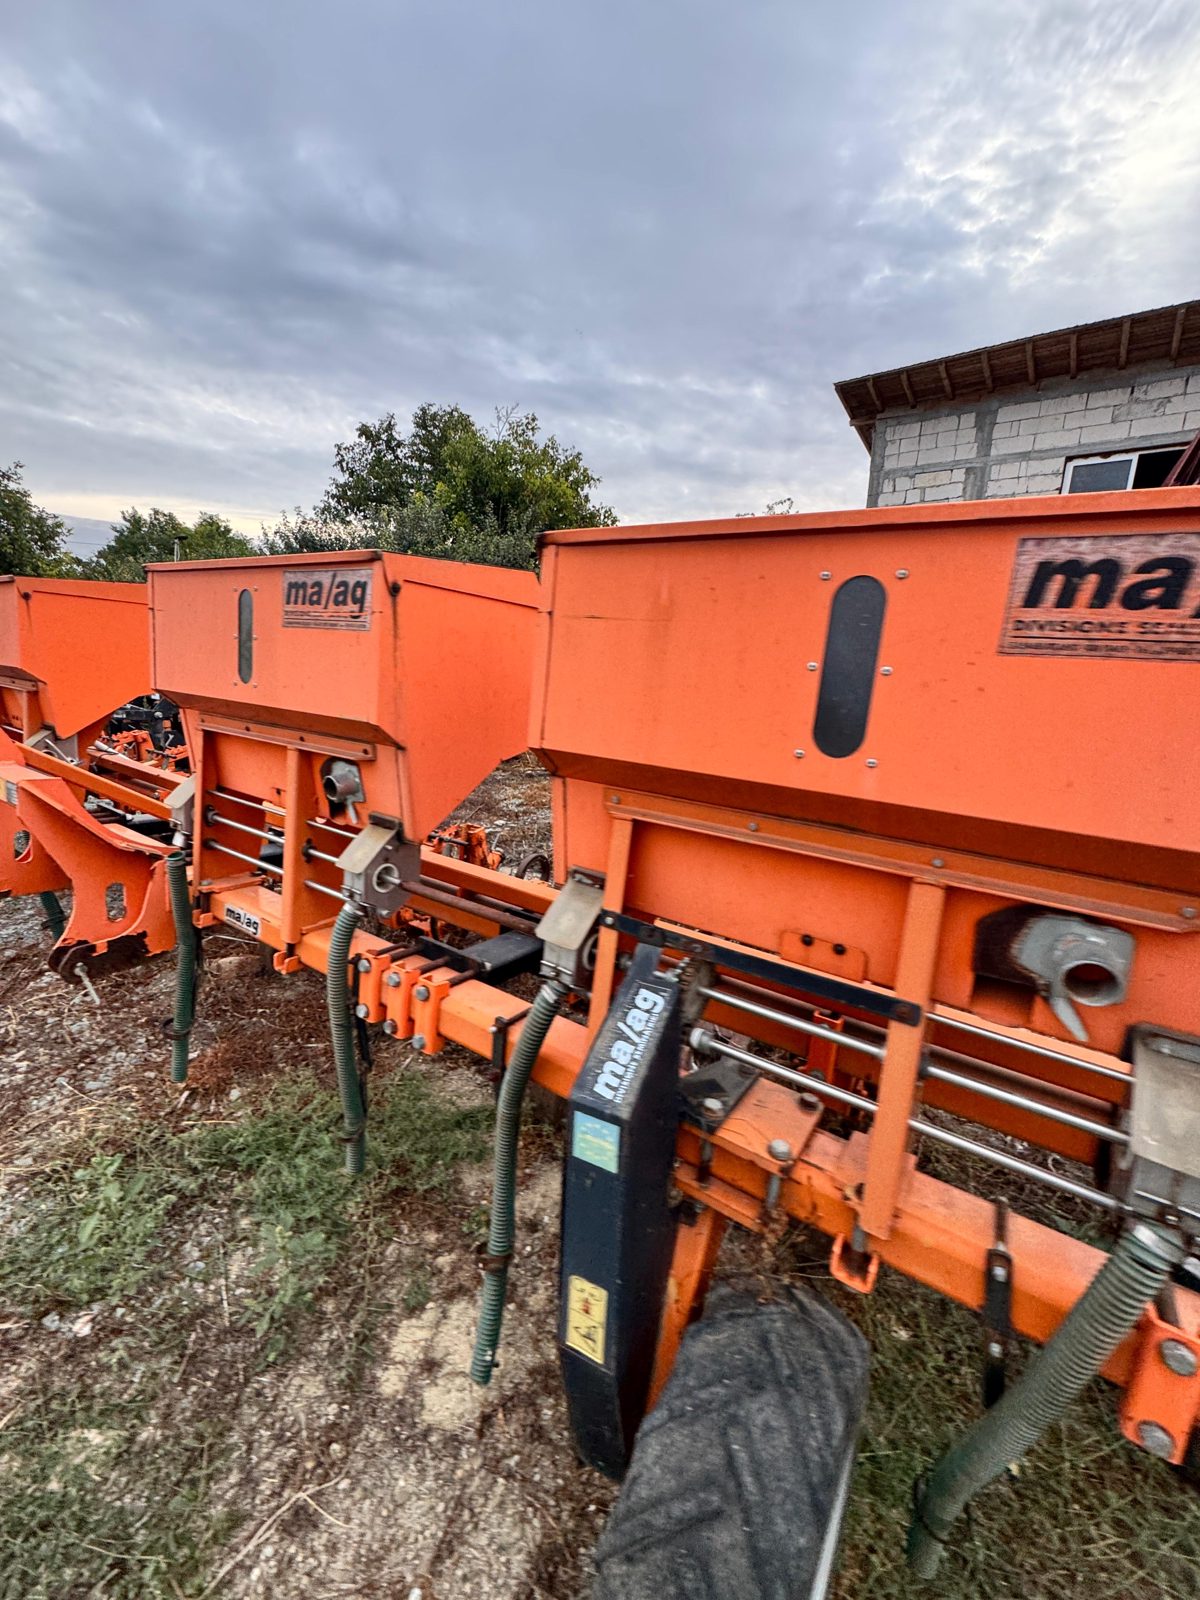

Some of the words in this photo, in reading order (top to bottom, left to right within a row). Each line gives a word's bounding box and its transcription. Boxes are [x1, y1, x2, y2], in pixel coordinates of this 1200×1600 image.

[1022, 557, 1200, 618] ma
[226, 907, 259, 935] ma/ag
[593, 988, 665, 1101] ma/ag
